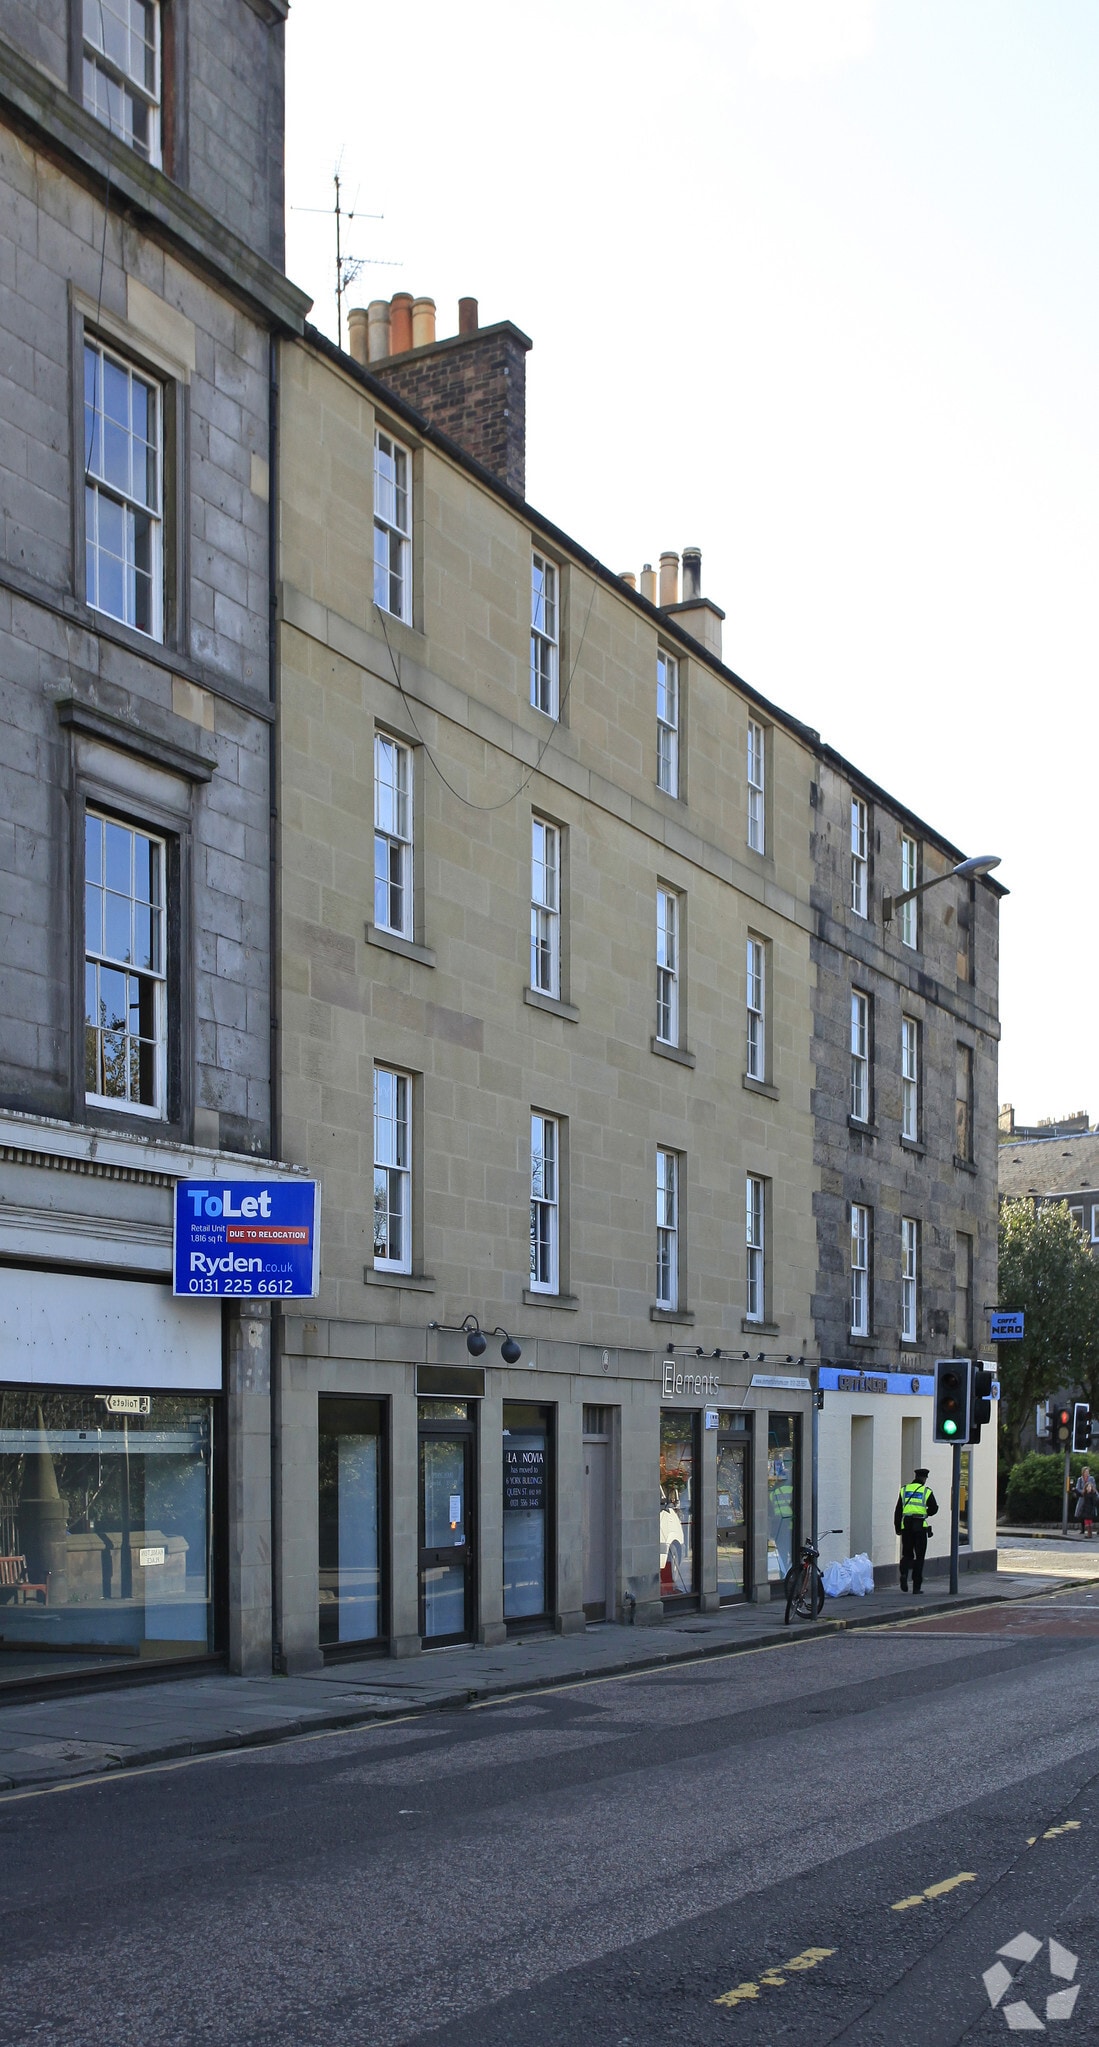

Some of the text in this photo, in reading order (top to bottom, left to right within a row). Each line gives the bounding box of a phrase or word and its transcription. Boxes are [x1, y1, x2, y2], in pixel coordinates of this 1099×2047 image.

[258, 1231, 306, 1239] RELOCATION
[190, 1252, 293, 1276] Ryden.co.uk
[189, 1279, 293, 1293] 0131 225 6612
[992, 1326, 1022, 1334] NERO
[662, 1361, 720, 1398] Elements
[507, 1452, 544, 1463] LA NOVIA
[507, 1488, 520, 1497] QUEEN
